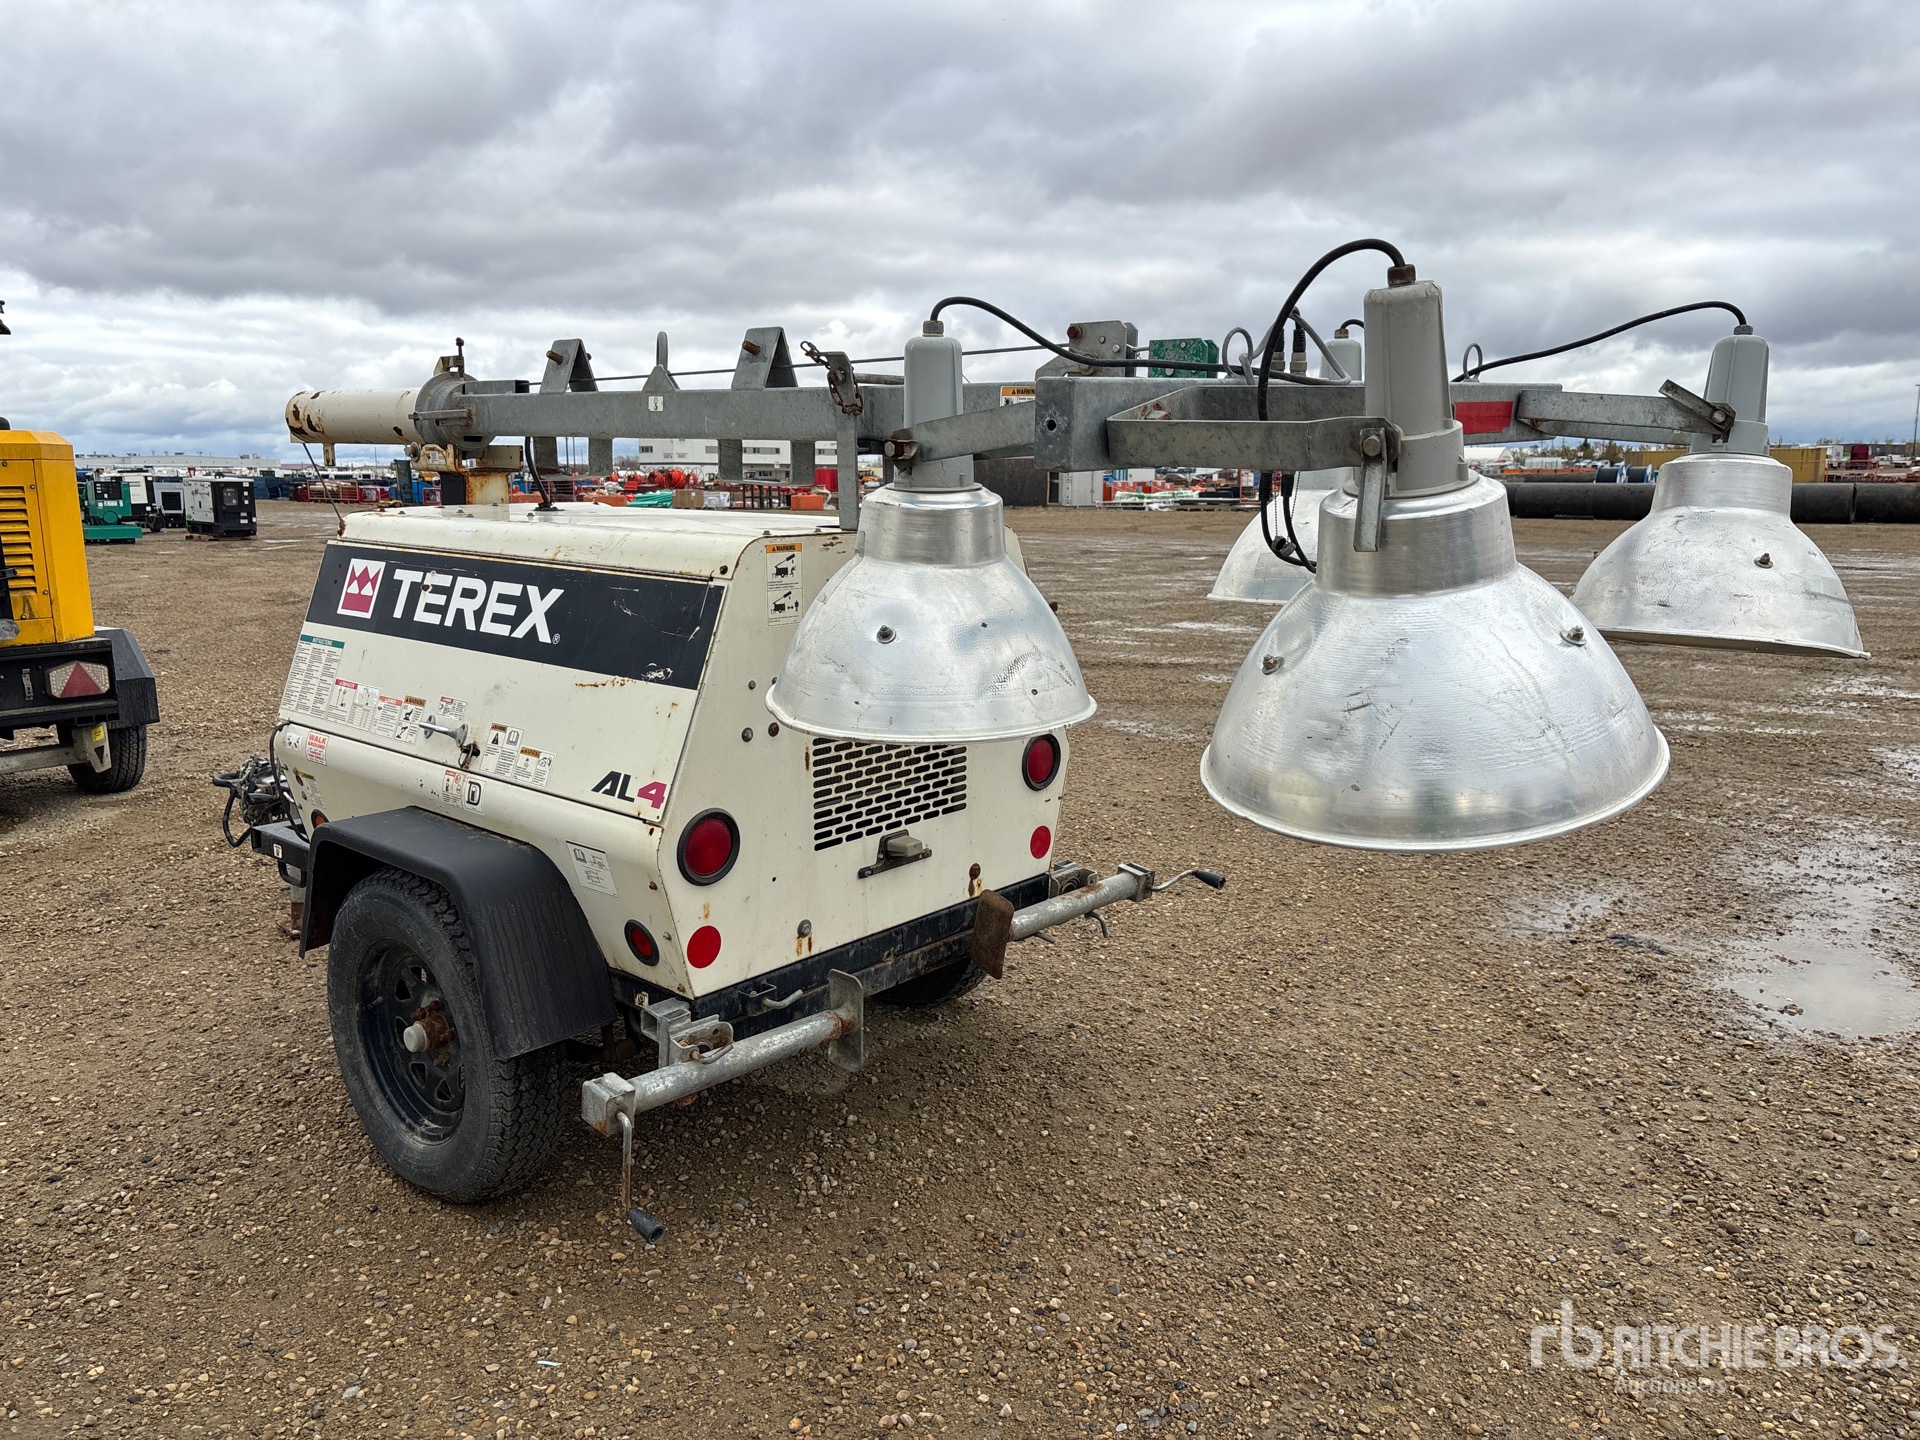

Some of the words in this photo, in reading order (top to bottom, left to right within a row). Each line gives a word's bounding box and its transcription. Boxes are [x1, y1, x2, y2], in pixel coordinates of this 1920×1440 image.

[776, 544, 796, 552] WARNING
[309, 734, 327, 745] WALK
[308, 741, 326, 750] AROUND
[591, 771, 667, 810] AL4
